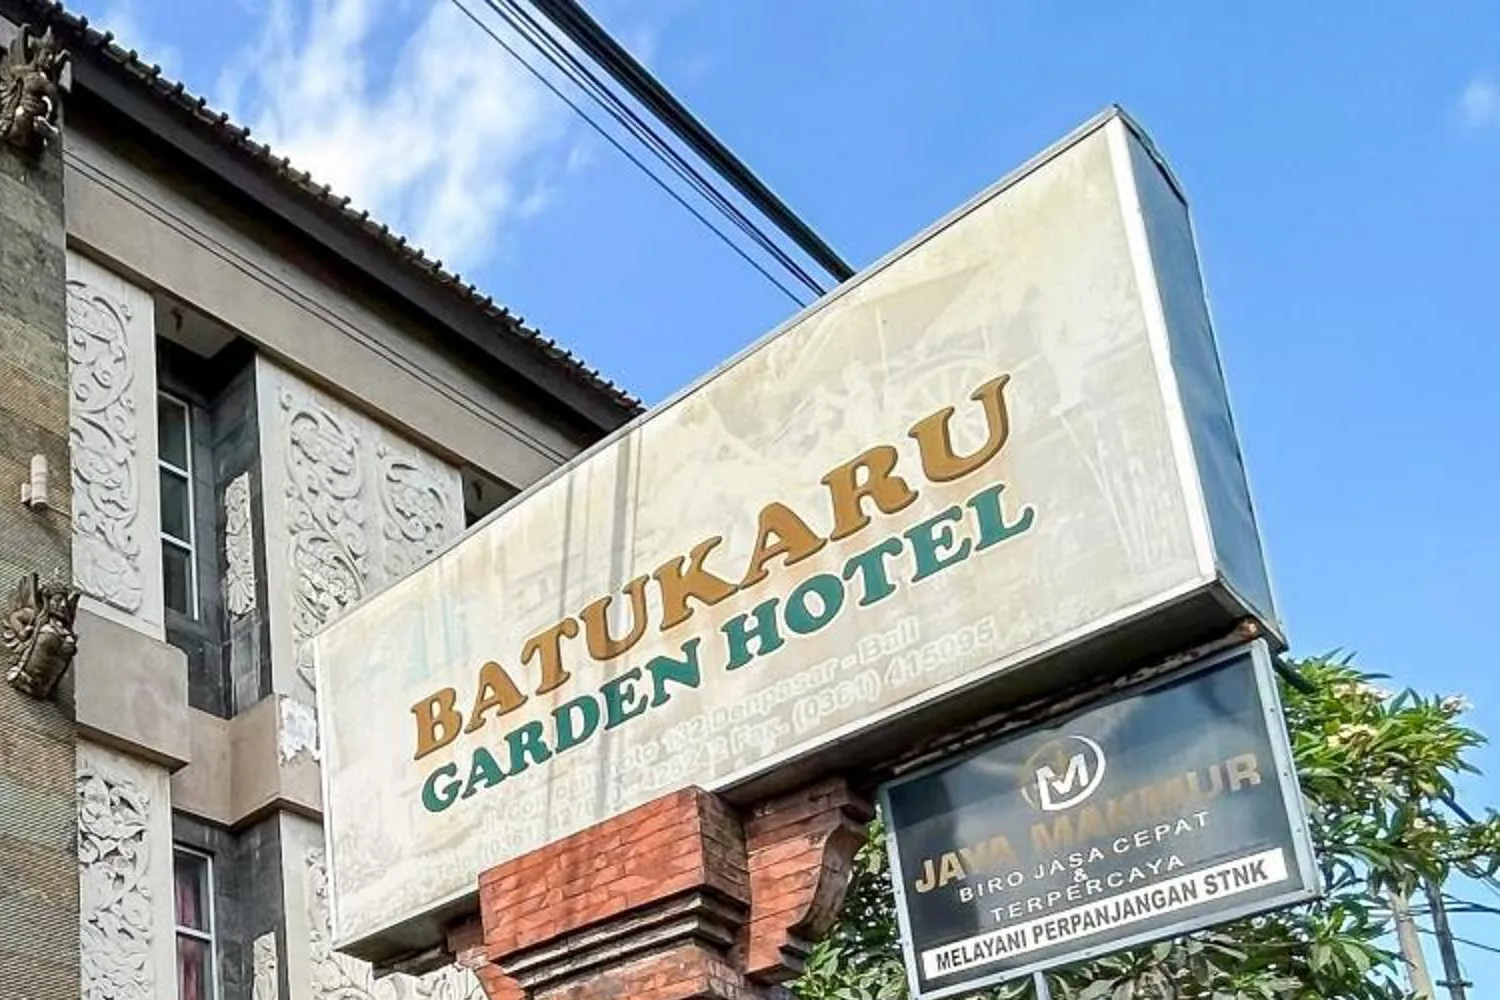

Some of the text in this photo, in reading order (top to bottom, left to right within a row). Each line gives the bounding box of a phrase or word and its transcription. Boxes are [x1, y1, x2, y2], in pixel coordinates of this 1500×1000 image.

[410, 374, 1012, 761] BATUKARU
[421, 484, 1034, 814] GARDEN HOTEL
[709, 655, 838, 732] Denpasar
[857, 615, 920, 667] Bali
[915, 752, 1261, 893] JAYA MAKMUR
[959, 810, 1210, 903] BIRO JASA CEPAT
[1073, 867, 1089, 883] &
[936, 859, 1269, 972] MELAYANI PERPANJANGAN STNK
[990, 854, 1186, 923] TERPERCAYA
